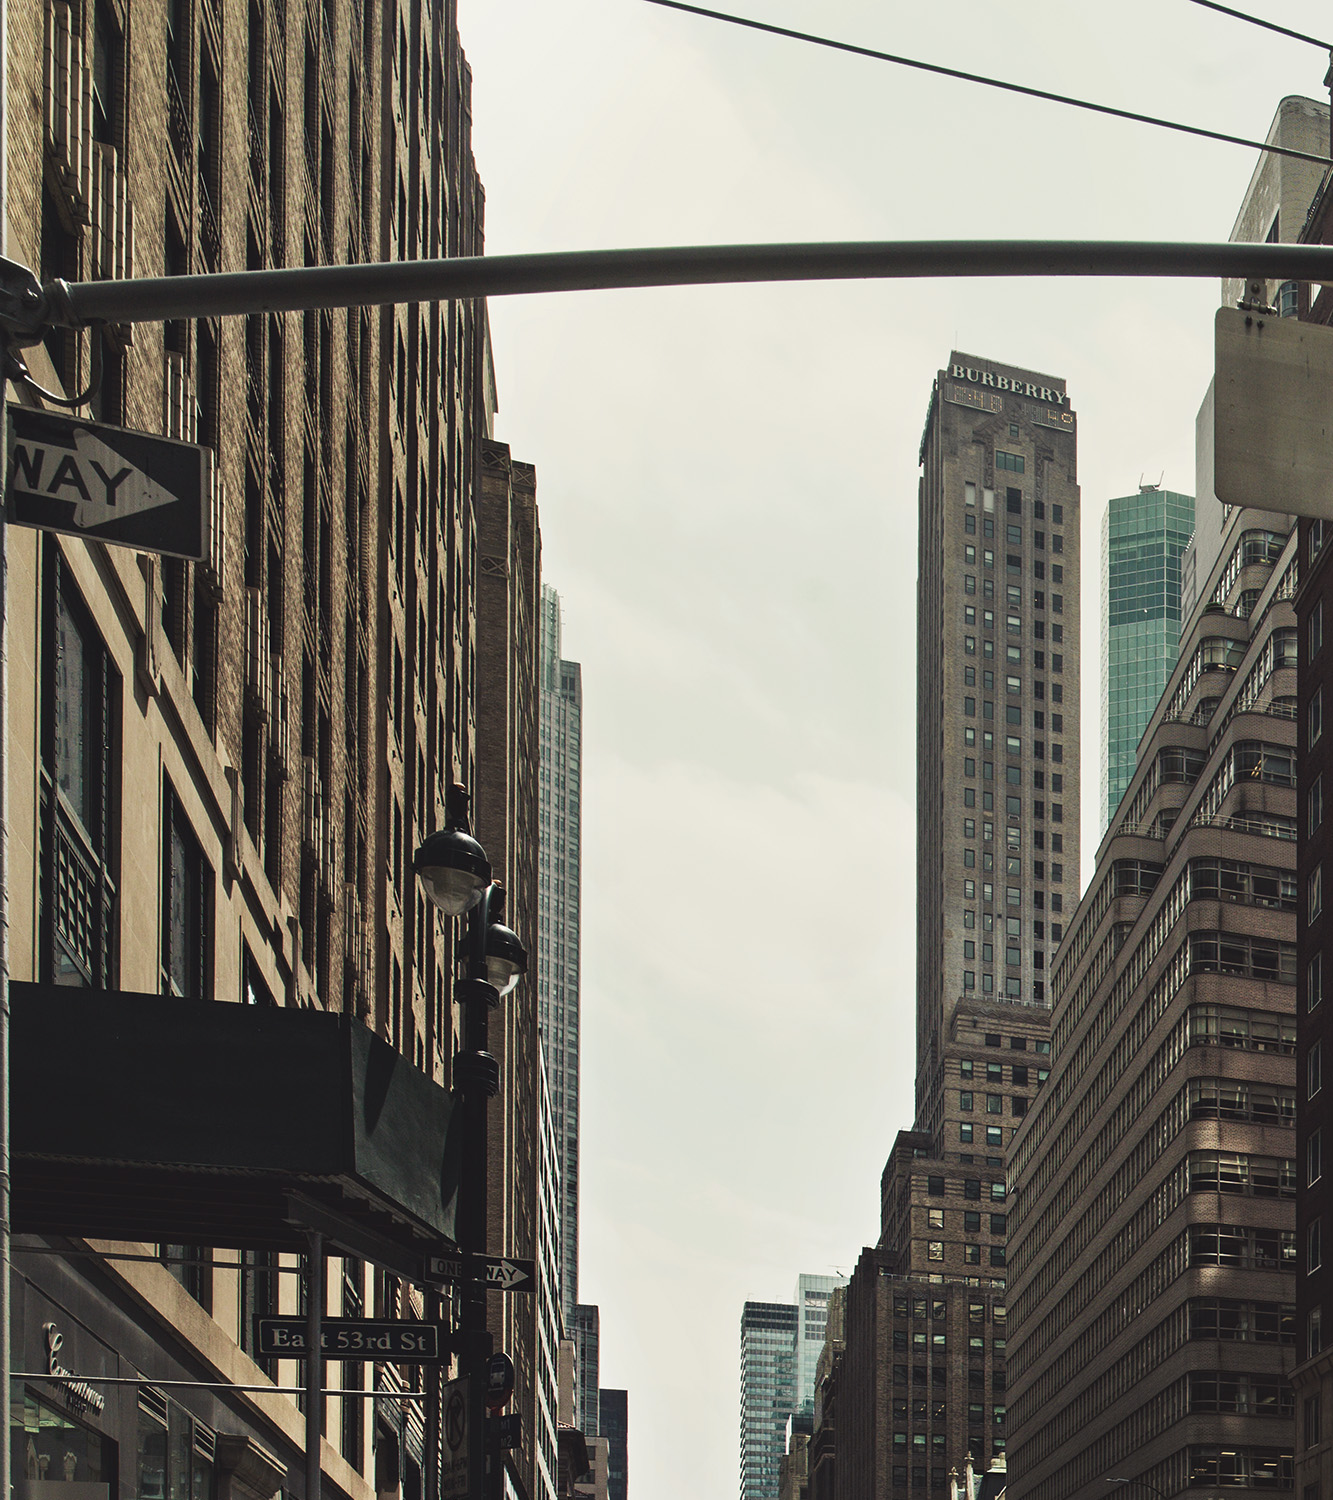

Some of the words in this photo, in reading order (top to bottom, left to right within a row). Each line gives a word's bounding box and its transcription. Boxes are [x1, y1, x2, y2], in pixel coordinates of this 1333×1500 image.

[951, 363, 1066, 405] BURBERRY
[272, 1328, 328, 1348] Eat
[337, 1331, 392, 1350] 53rd
[400, 1332, 426, 1351] St
